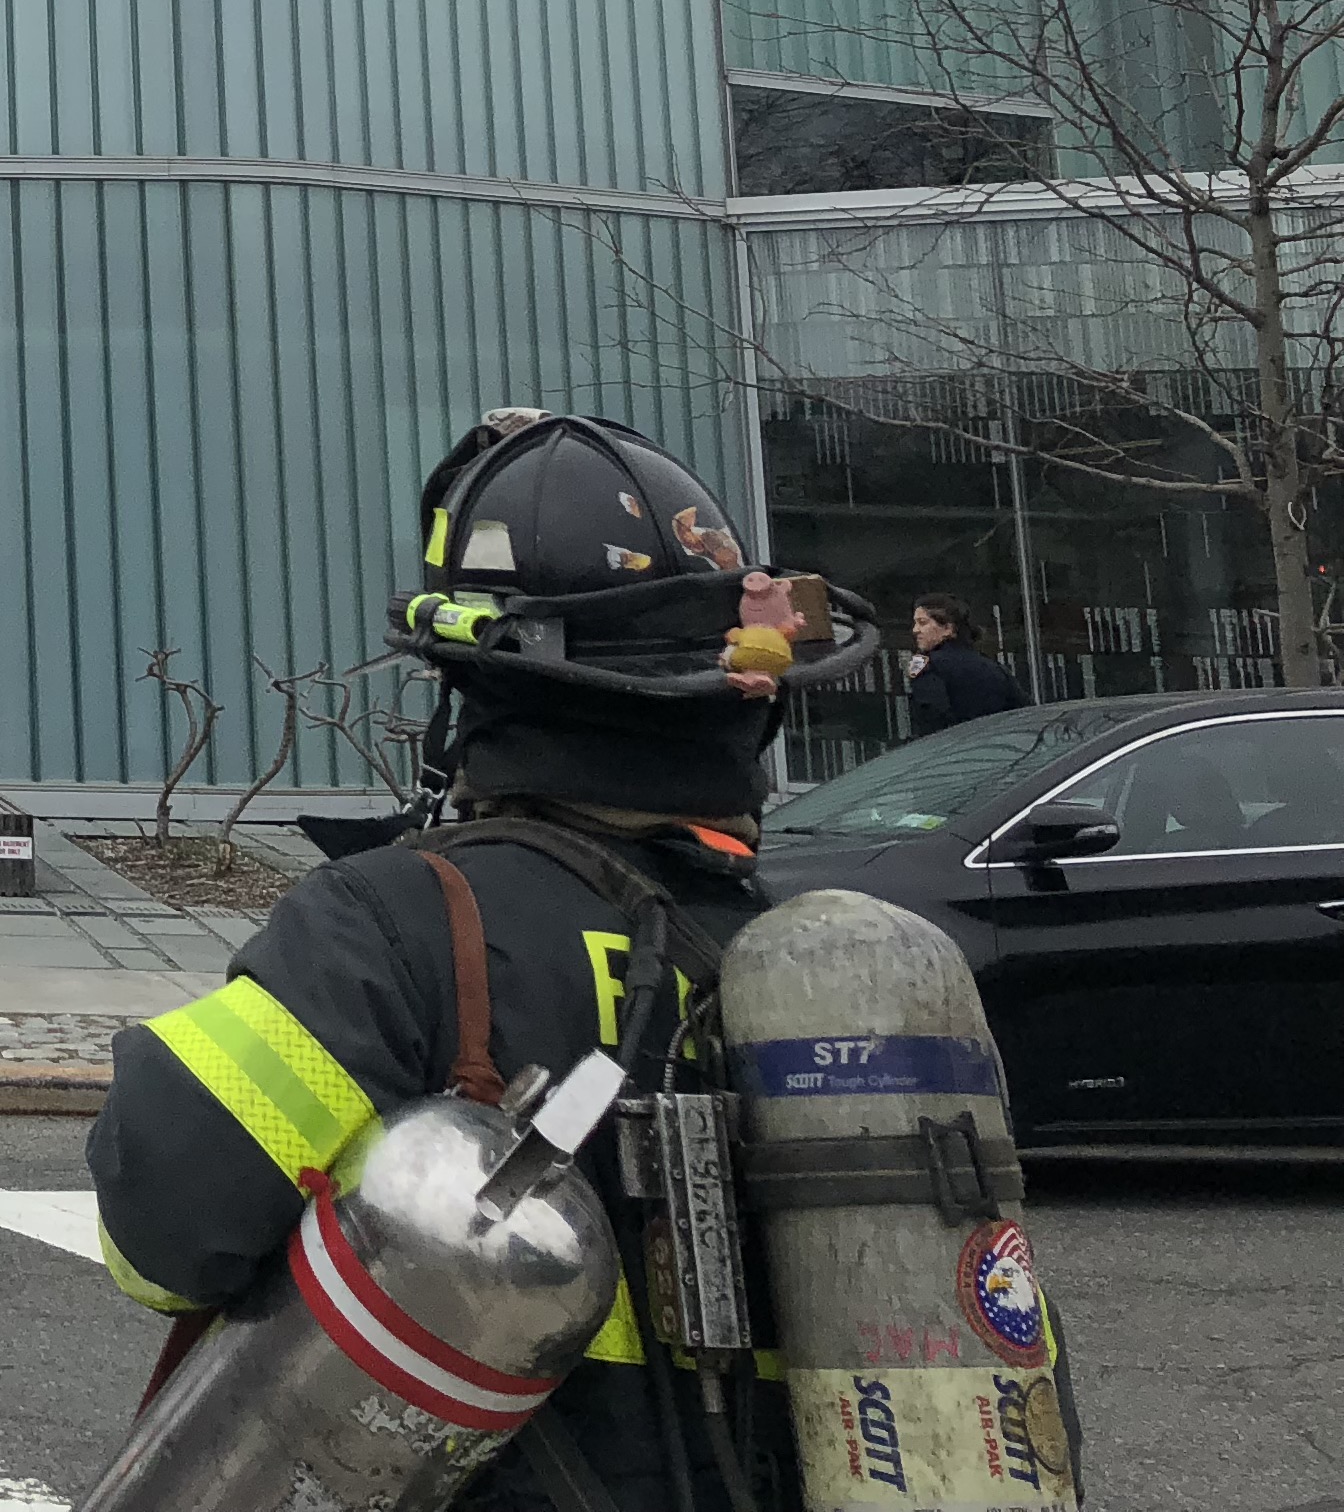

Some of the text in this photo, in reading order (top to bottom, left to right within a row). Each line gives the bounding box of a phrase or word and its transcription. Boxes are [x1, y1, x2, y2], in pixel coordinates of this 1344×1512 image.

[786, 1072, 824, 1089] SCOTT
[813, 1040, 875, 1066] ST7
[838, 1396, 864, 1480] AIR-PAK
[853, 1374, 908, 1493] SCOTT
[975, 1395, 1004, 1479] AIR-PAK
[992, 1374, 1041, 1491] SCOTT
